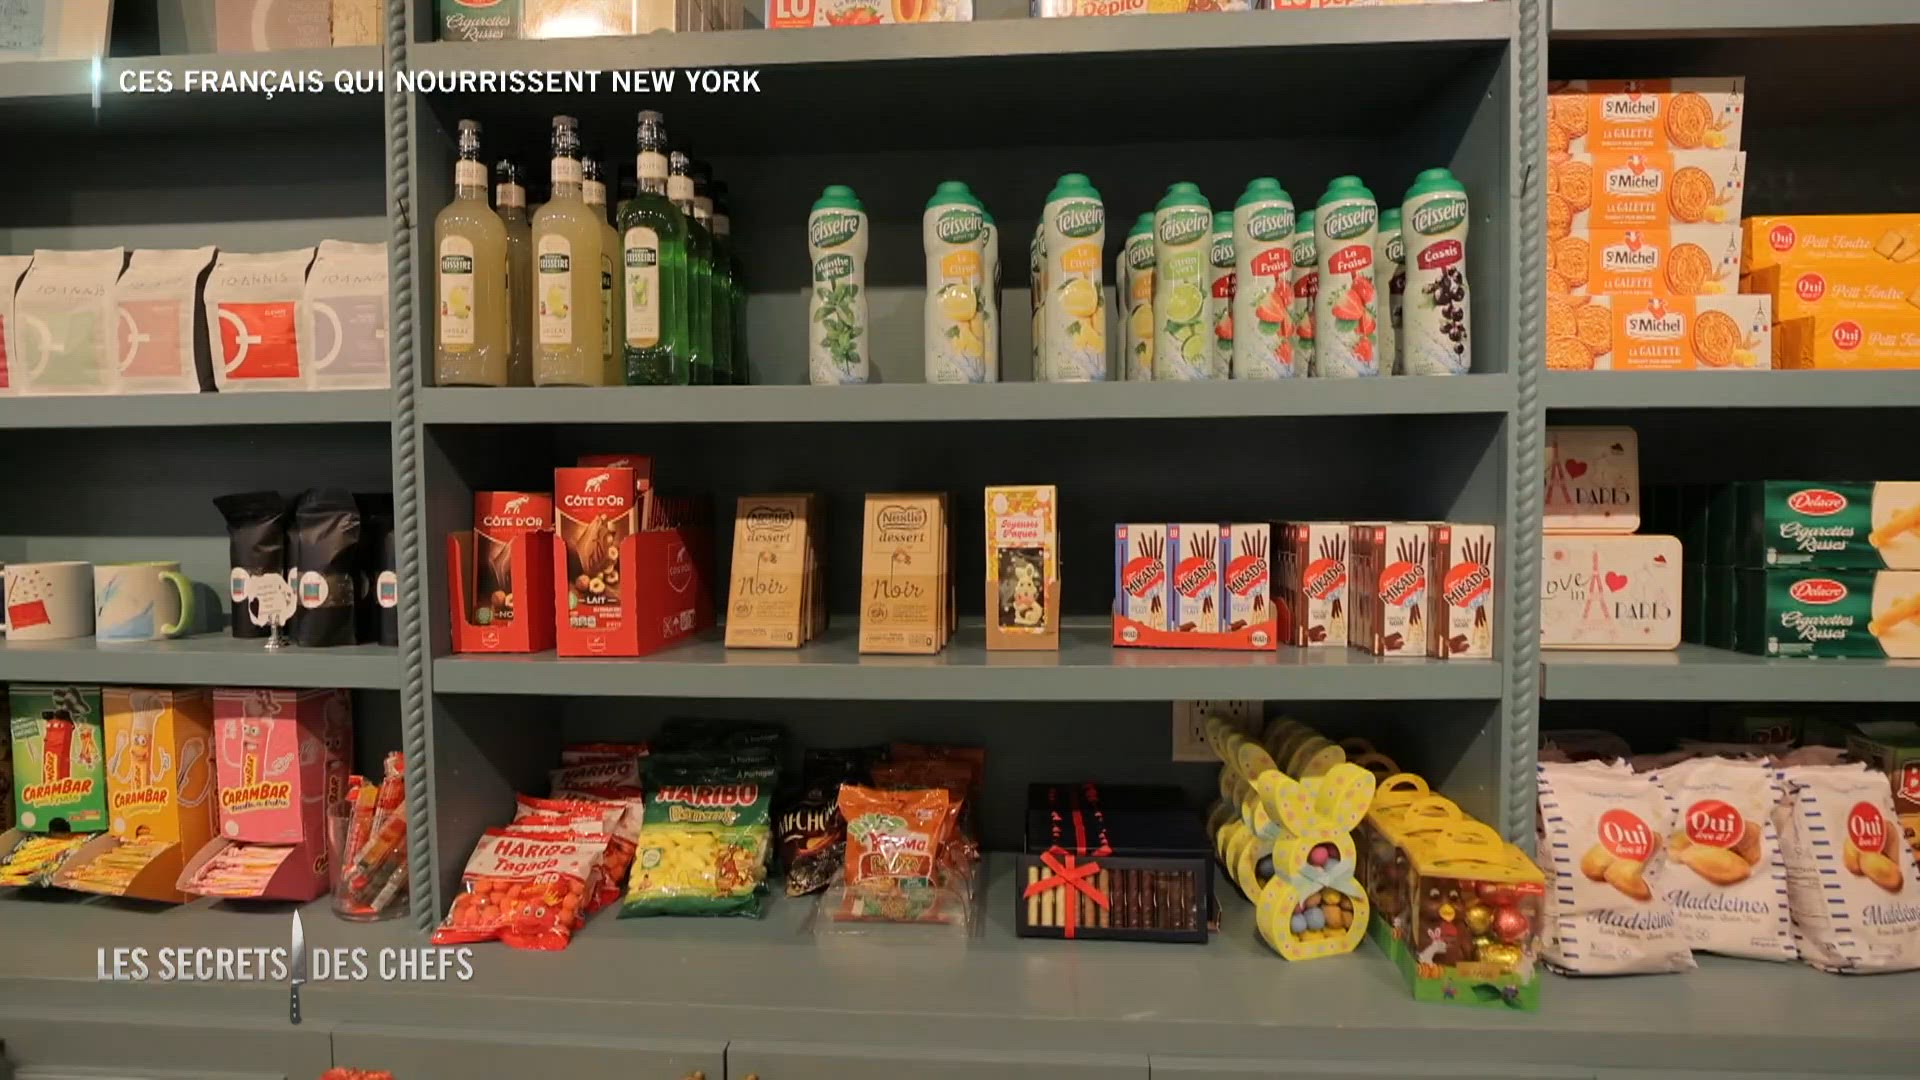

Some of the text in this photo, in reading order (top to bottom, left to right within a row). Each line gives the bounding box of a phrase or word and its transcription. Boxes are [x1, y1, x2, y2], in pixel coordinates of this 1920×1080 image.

[1615, 101, 1655, 113] Michel
[1614, 128, 1653, 138] GALETTE
[1618, 175, 1658, 187] Michel
[1617, 201, 1654, 212] GALETTE
[1325, 206, 1376, 239] Teisseire
[1415, 200, 1465, 233] Teisseire
[811, 217, 858, 243] Teisseire
[1160, 214, 1208, 243] Teisseire
[1771, 231, 1793, 246] Oui
[627, 252, 656, 263] TEISSEIRE
[1268, 252, 1280, 260] La
[1345, 250, 1357, 259] La
[1425, 245, 1458, 263] Cassis
[1615, 251, 1655, 264] Michel
[442, 261, 471, 270] TEISSEIRE
[540, 260, 568, 270] TEISSEIRE
[817, 257, 849, 272] Menthe
[822, 266, 845, 277] verte
[1261, 261, 1288, 272] Fraise
[1338, 259, 1367, 272] Fraise
[1614, 277, 1652, 288] GALETTE
[1799, 279, 1823, 294] Oui
[1639, 319, 1680, 331] Michel
[1834, 328, 1859, 343] Oui
[1640, 345, 1680, 356] GALETTE
[564, 493, 624, 506] CÔTE D'OR
[1576, 487, 1630, 505] PARIS
[1793, 492, 1842, 509] Delacre
[483, 515, 513, 527] CÔTE
[747, 532, 790, 543] dessert
[879, 531, 924, 543] dessert
[1780, 521, 1854, 542] Cigarettes
[1797, 537, 1848, 552] Russes
[1123, 558, 1165, 597] MIKADO
[1175, 558, 1217, 597] MIKADO
[1226, 558, 1268, 595] MIKADO
[1303, 560, 1346, 600] MIKADO
[1380, 564, 1425, 604] MIKADO
[739, 576, 788, 596] Noir
[872, 577, 924, 599] Noir
[1444, 564, 1491, 607] MIKADO
[1793, 582, 1843, 598] Delacre
[1614, 602, 1672, 620] PARIS
[1781, 611, 1854, 631] Cigarettes
[1798, 625, 1848, 642] Russes
[22, 779, 92, 802] CARAMBAR
[114, 788, 168, 808] CARAMBAR
[222, 783, 289, 806] CARAMBAR
[655, 784, 758, 808] HARIBO
[1690, 810, 1736, 833] Oui
[1851, 814, 1882, 838] Oui
[1603, 821, 1648, 846] Oui
[494, 839, 577, 859] HARIBO
[494, 857, 559, 874] Tagada
[1662, 889, 1769, 915] Madeleines
[1586, 908, 1674, 931] Madelein
[1863, 904, 1920, 927] Madelein
